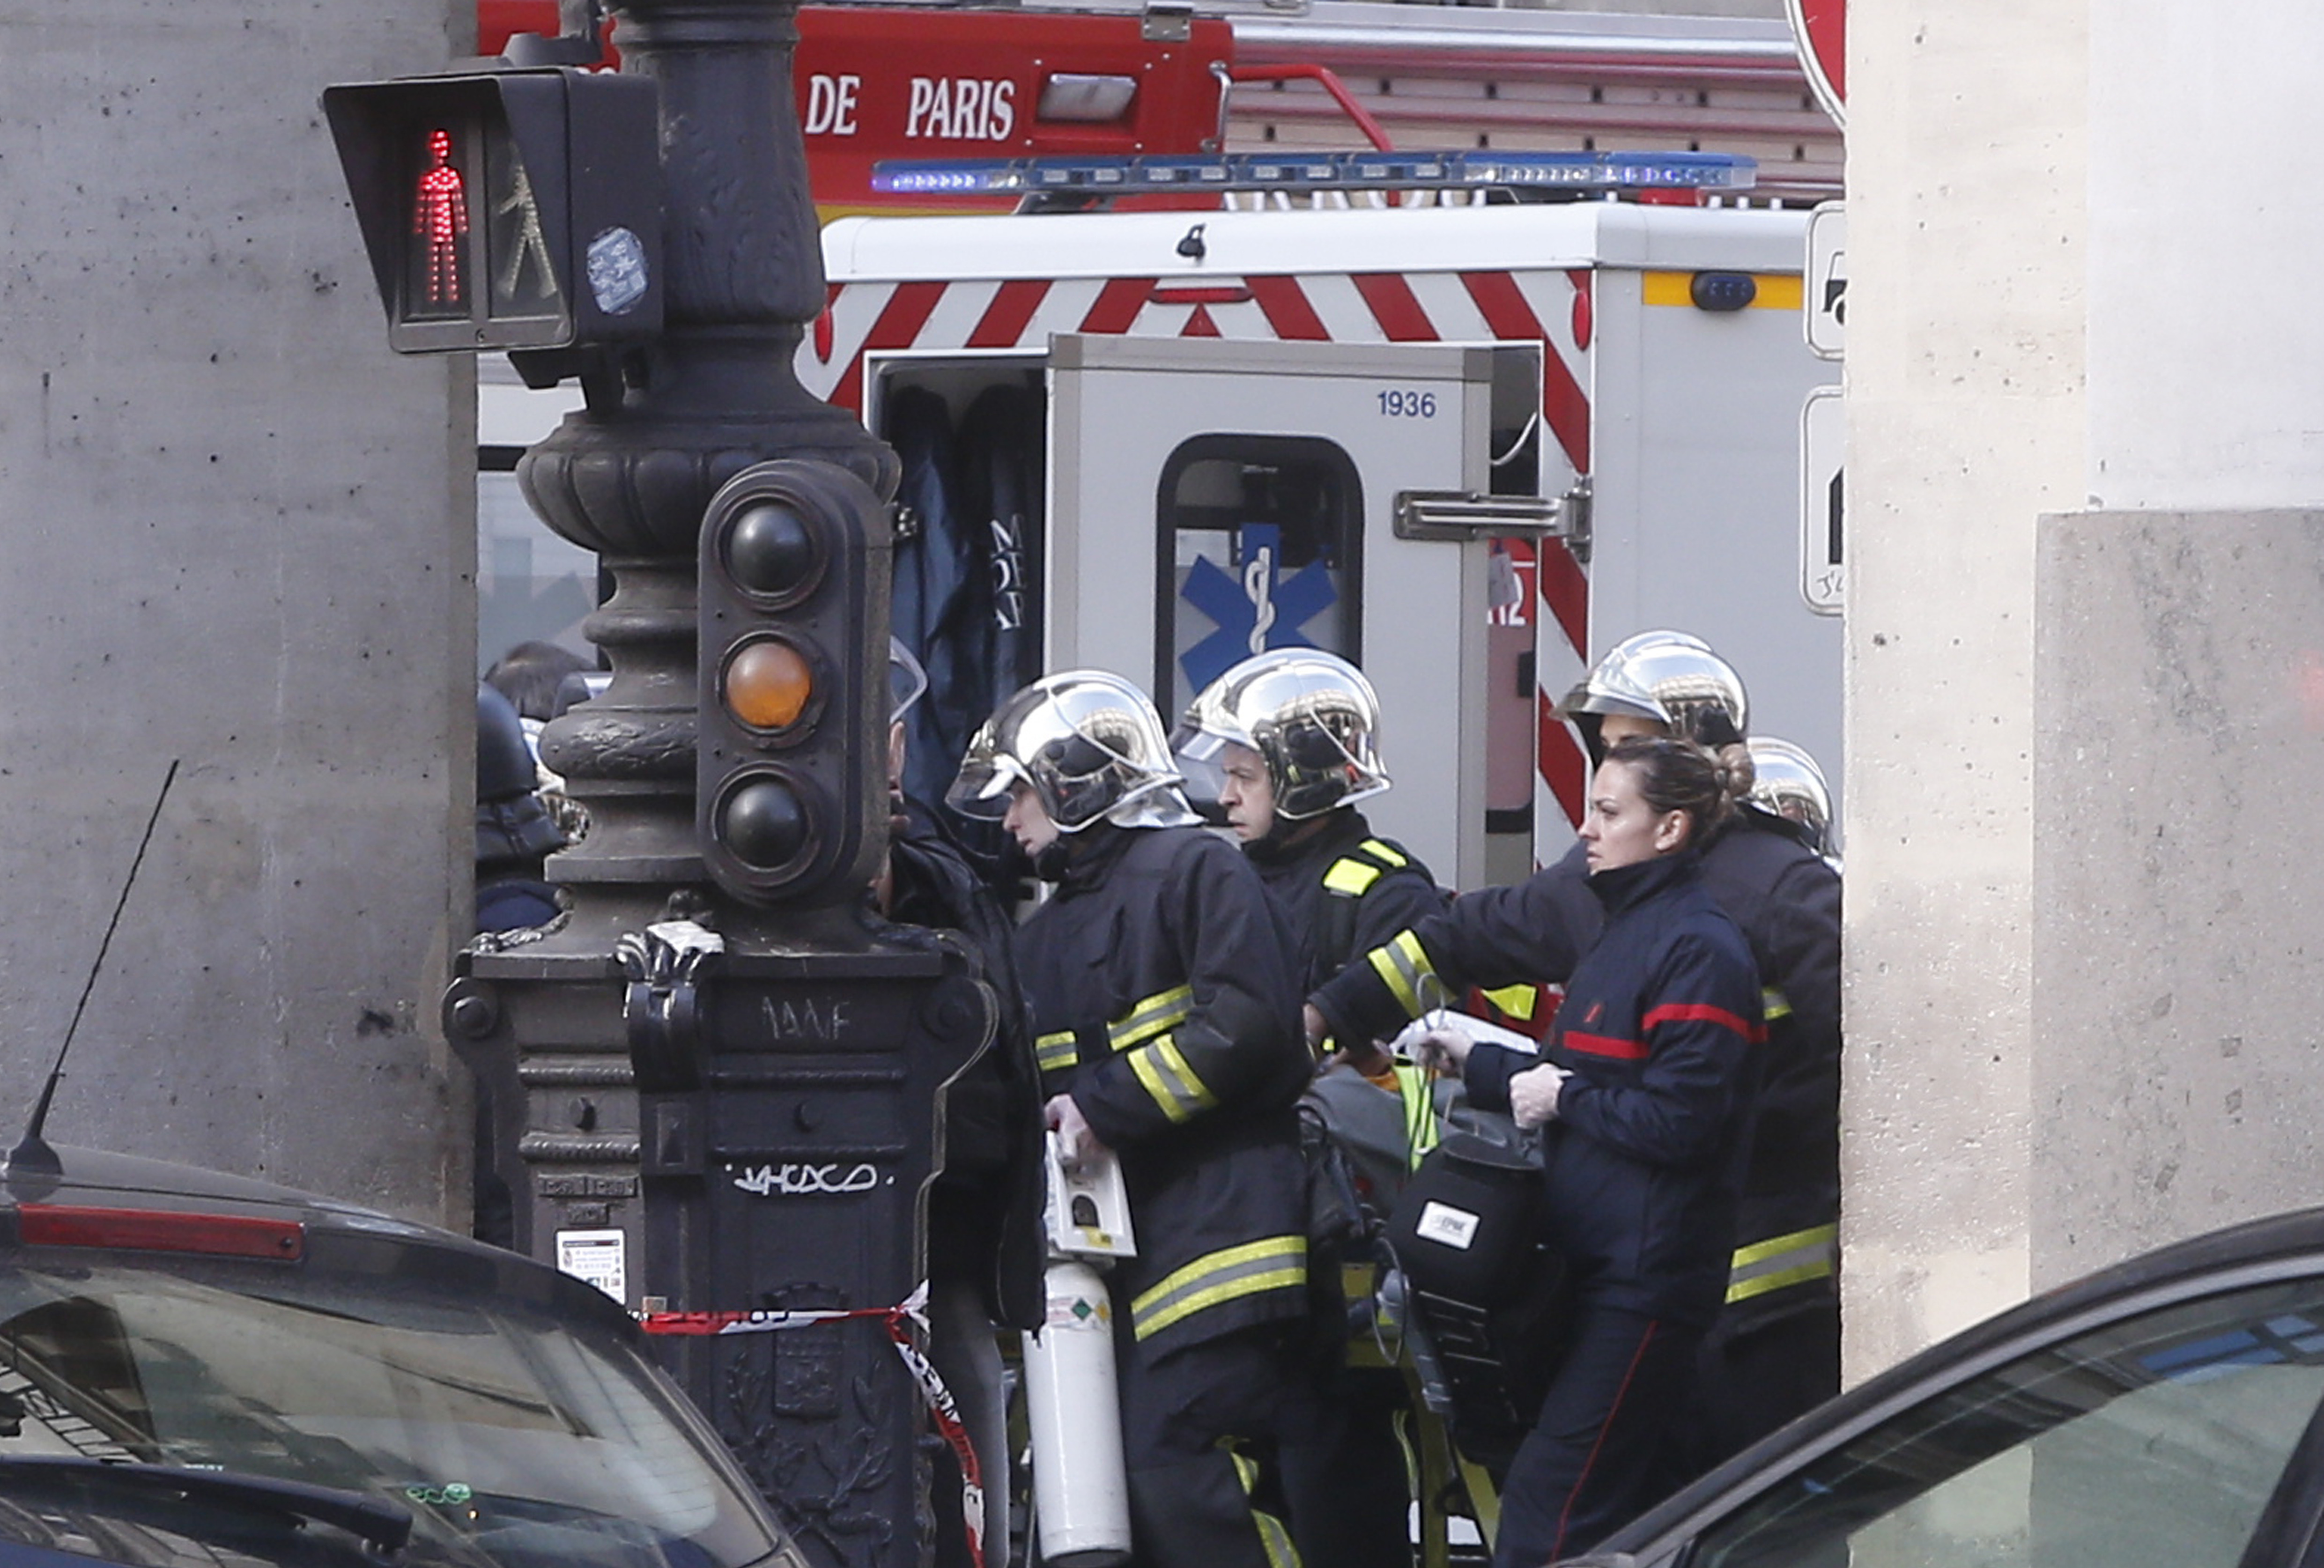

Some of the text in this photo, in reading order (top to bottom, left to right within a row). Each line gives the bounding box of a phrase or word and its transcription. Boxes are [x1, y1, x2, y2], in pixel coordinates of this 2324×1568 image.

[805, 75, 1015, 141] DE PARIS
[1377, 391, 1436, 418] 1936
